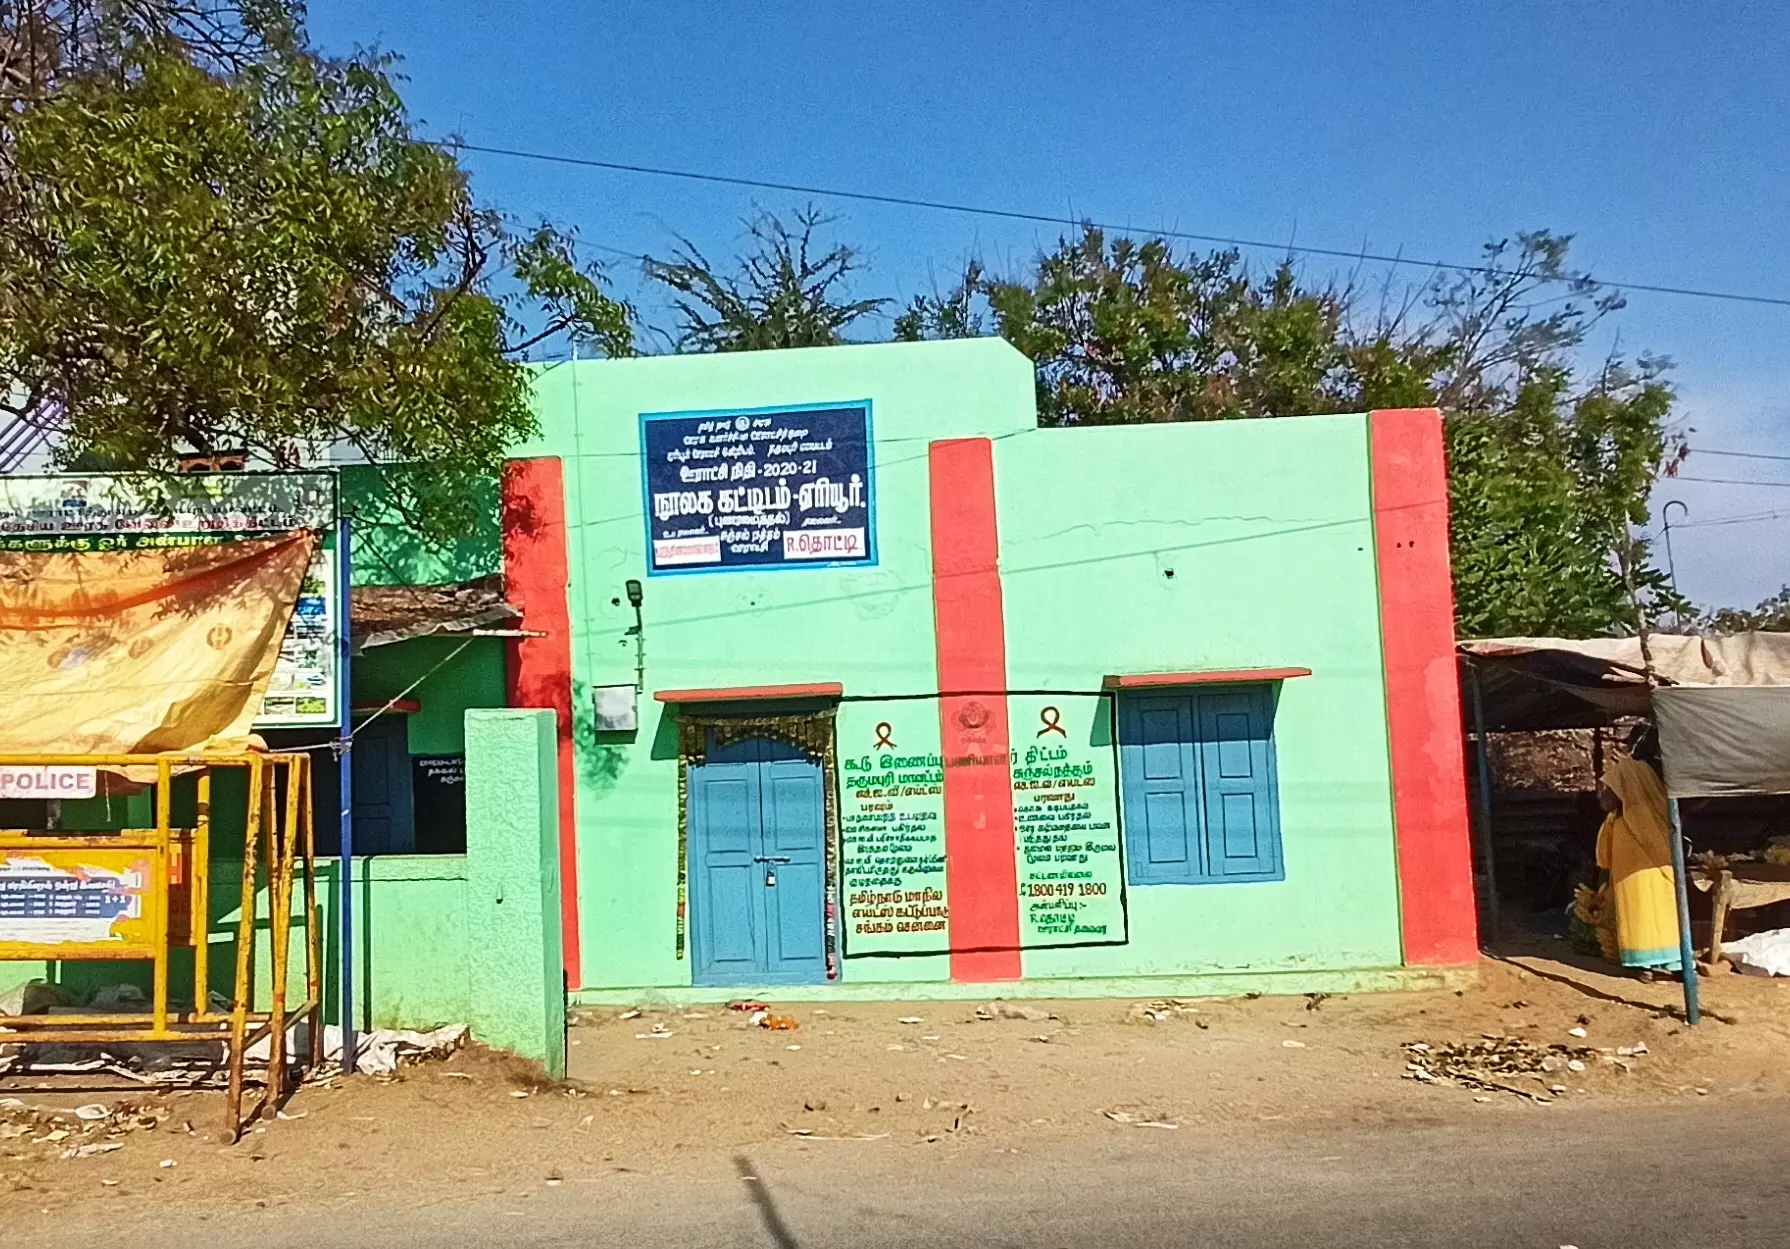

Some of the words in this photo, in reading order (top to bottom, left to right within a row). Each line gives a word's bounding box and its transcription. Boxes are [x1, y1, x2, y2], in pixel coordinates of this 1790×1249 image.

[679, 462, 728, 483] ஊராட்சி
[654, 490, 714, 521] நூலக
[1025, 745, 1068, 765] திட்டம்
[1, 773, 91, 790] POLICE
[846, 771, 895, 789] தருமபுரி
[904, 886, 943, 904] மாநில
[1027, 883, 1054, 897] 1800
[1055, 883, 1075, 896] 419
[1078, 882, 1107, 896] 1800
